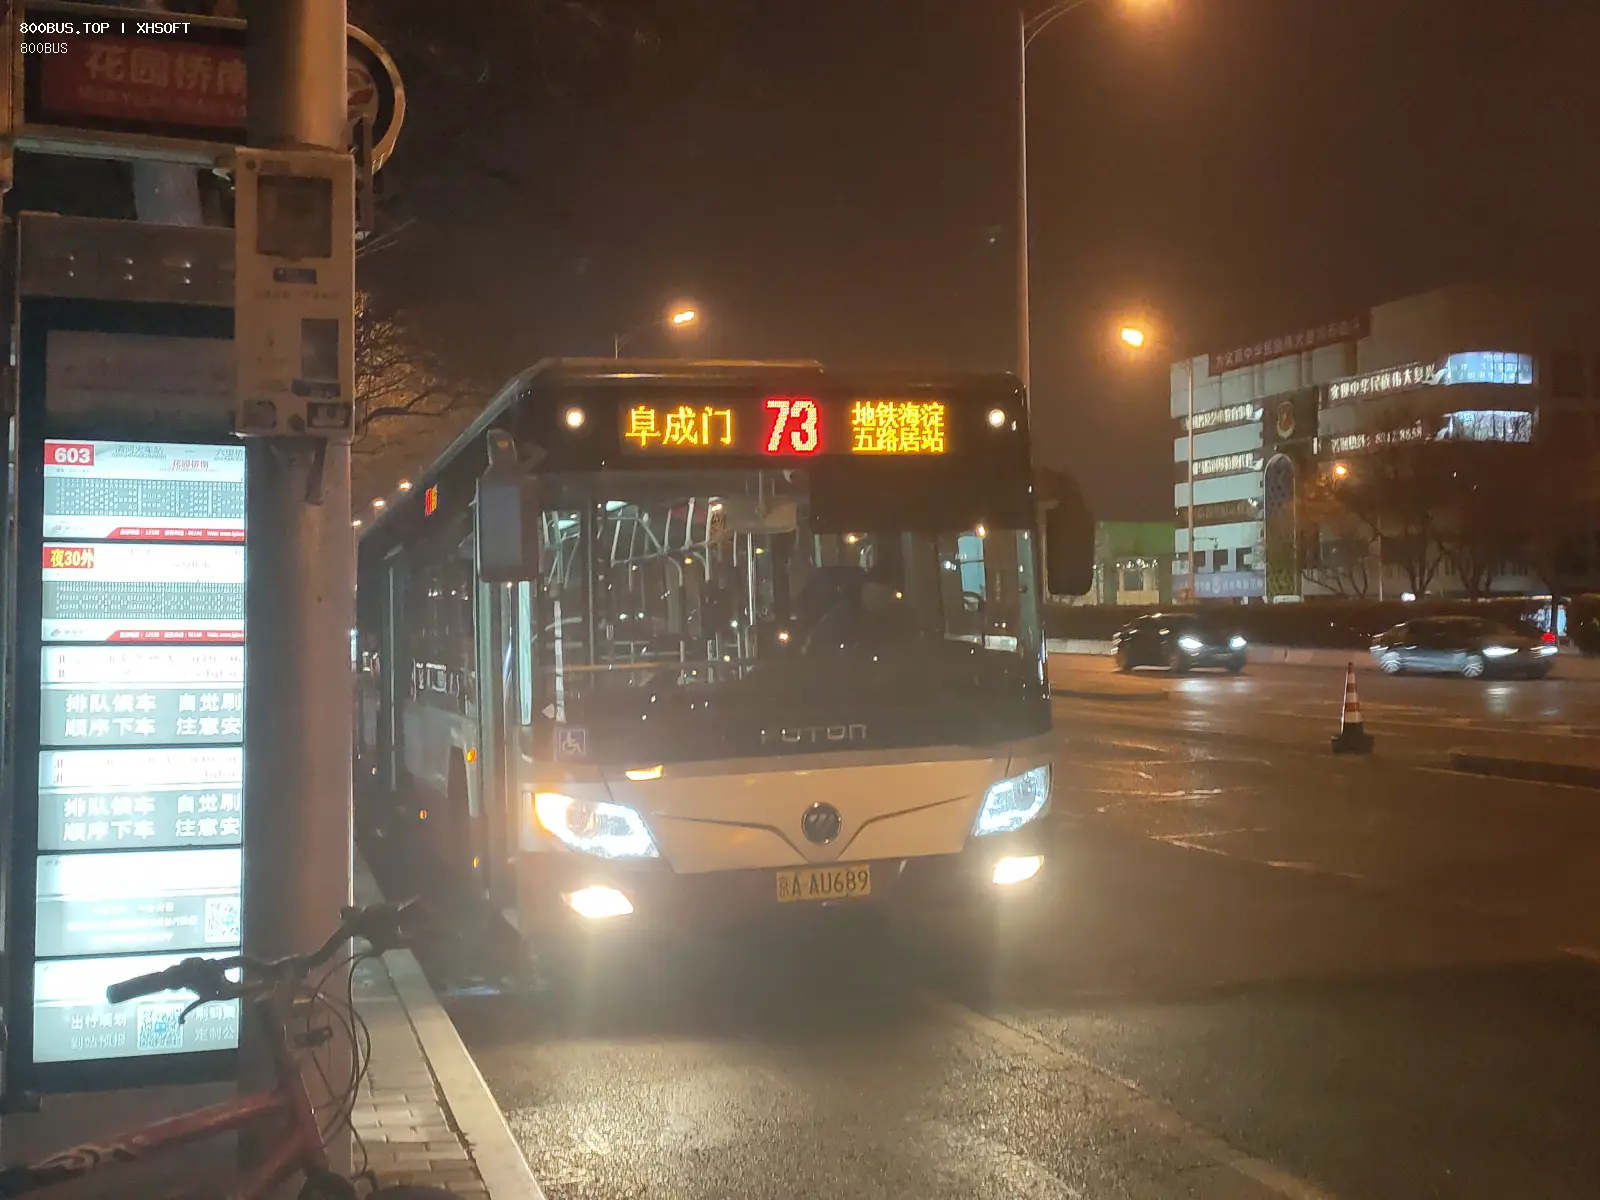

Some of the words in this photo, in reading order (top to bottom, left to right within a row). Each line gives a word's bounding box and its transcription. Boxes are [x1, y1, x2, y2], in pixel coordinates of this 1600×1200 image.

[625, 405, 732, 446] 阜成门
[766, 399, 819, 453] 73
[851, 401, 945, 427] 地铁海淀
[852, 427, 945, 453] 五路居站
[54, 447, 91, 464] 603
[50, 548, 94, 568] 夜30外
[64, 717, 156, 738] 顺序下车
[63, 819, 156, 842] 顺序下车
